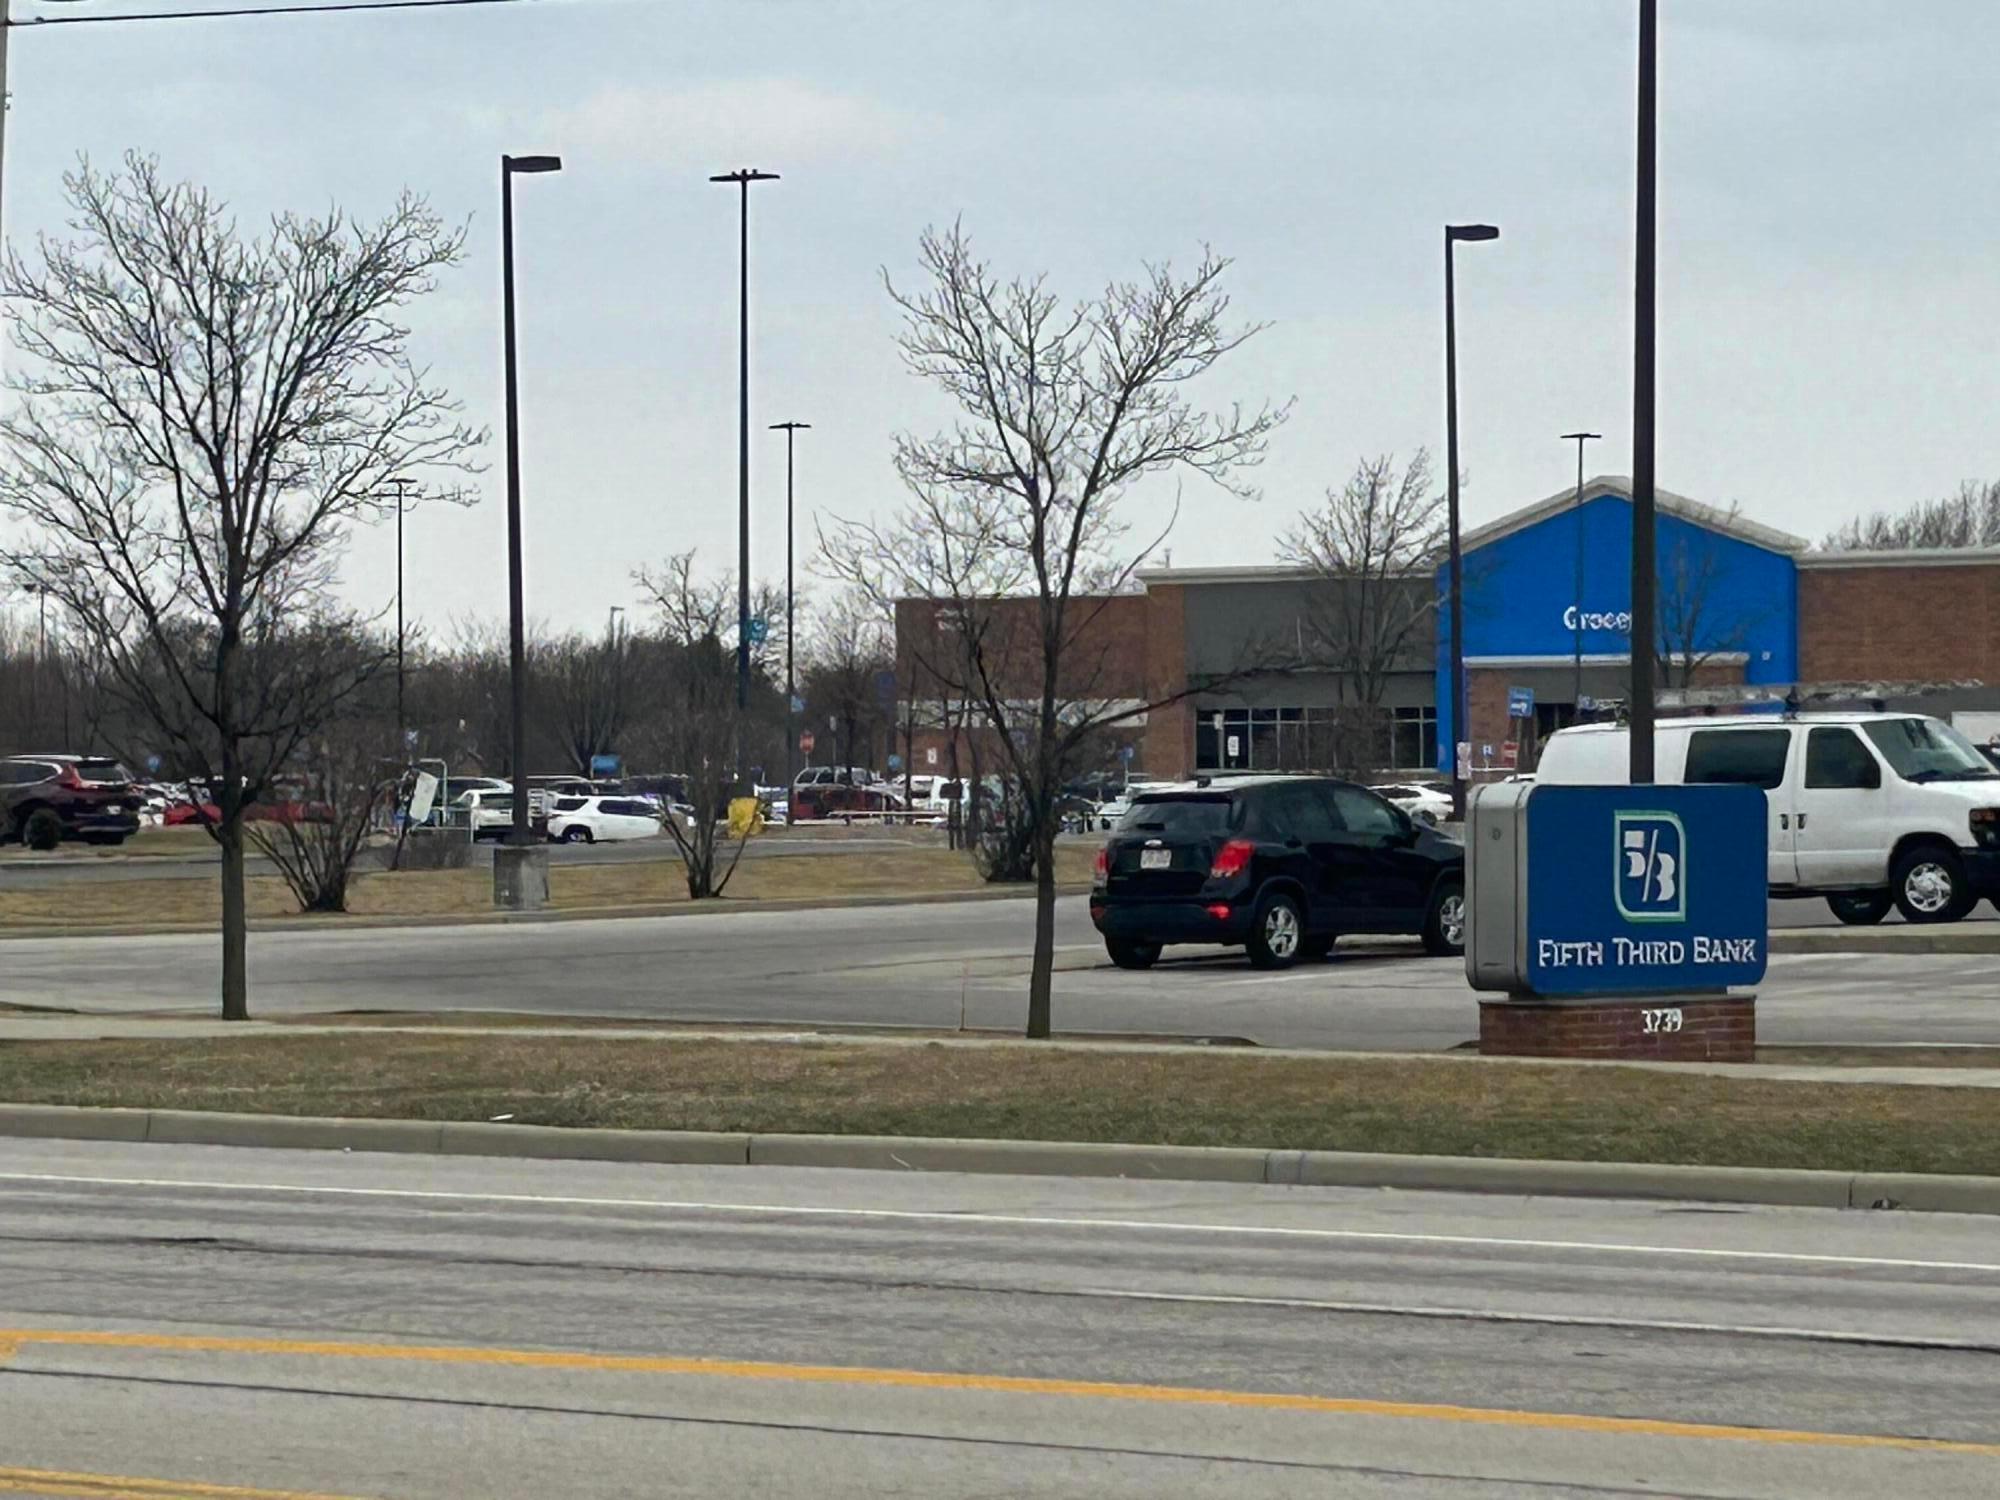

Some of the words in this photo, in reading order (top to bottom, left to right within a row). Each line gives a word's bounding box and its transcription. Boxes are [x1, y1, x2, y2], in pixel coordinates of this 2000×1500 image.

[1564, 606, 1633, 633] Groce
[1539, 939, 1603, 967] FIFTH
[1612, 937, 1684, 966] THIRD
[1693, 936, 1757, 963] BANK
